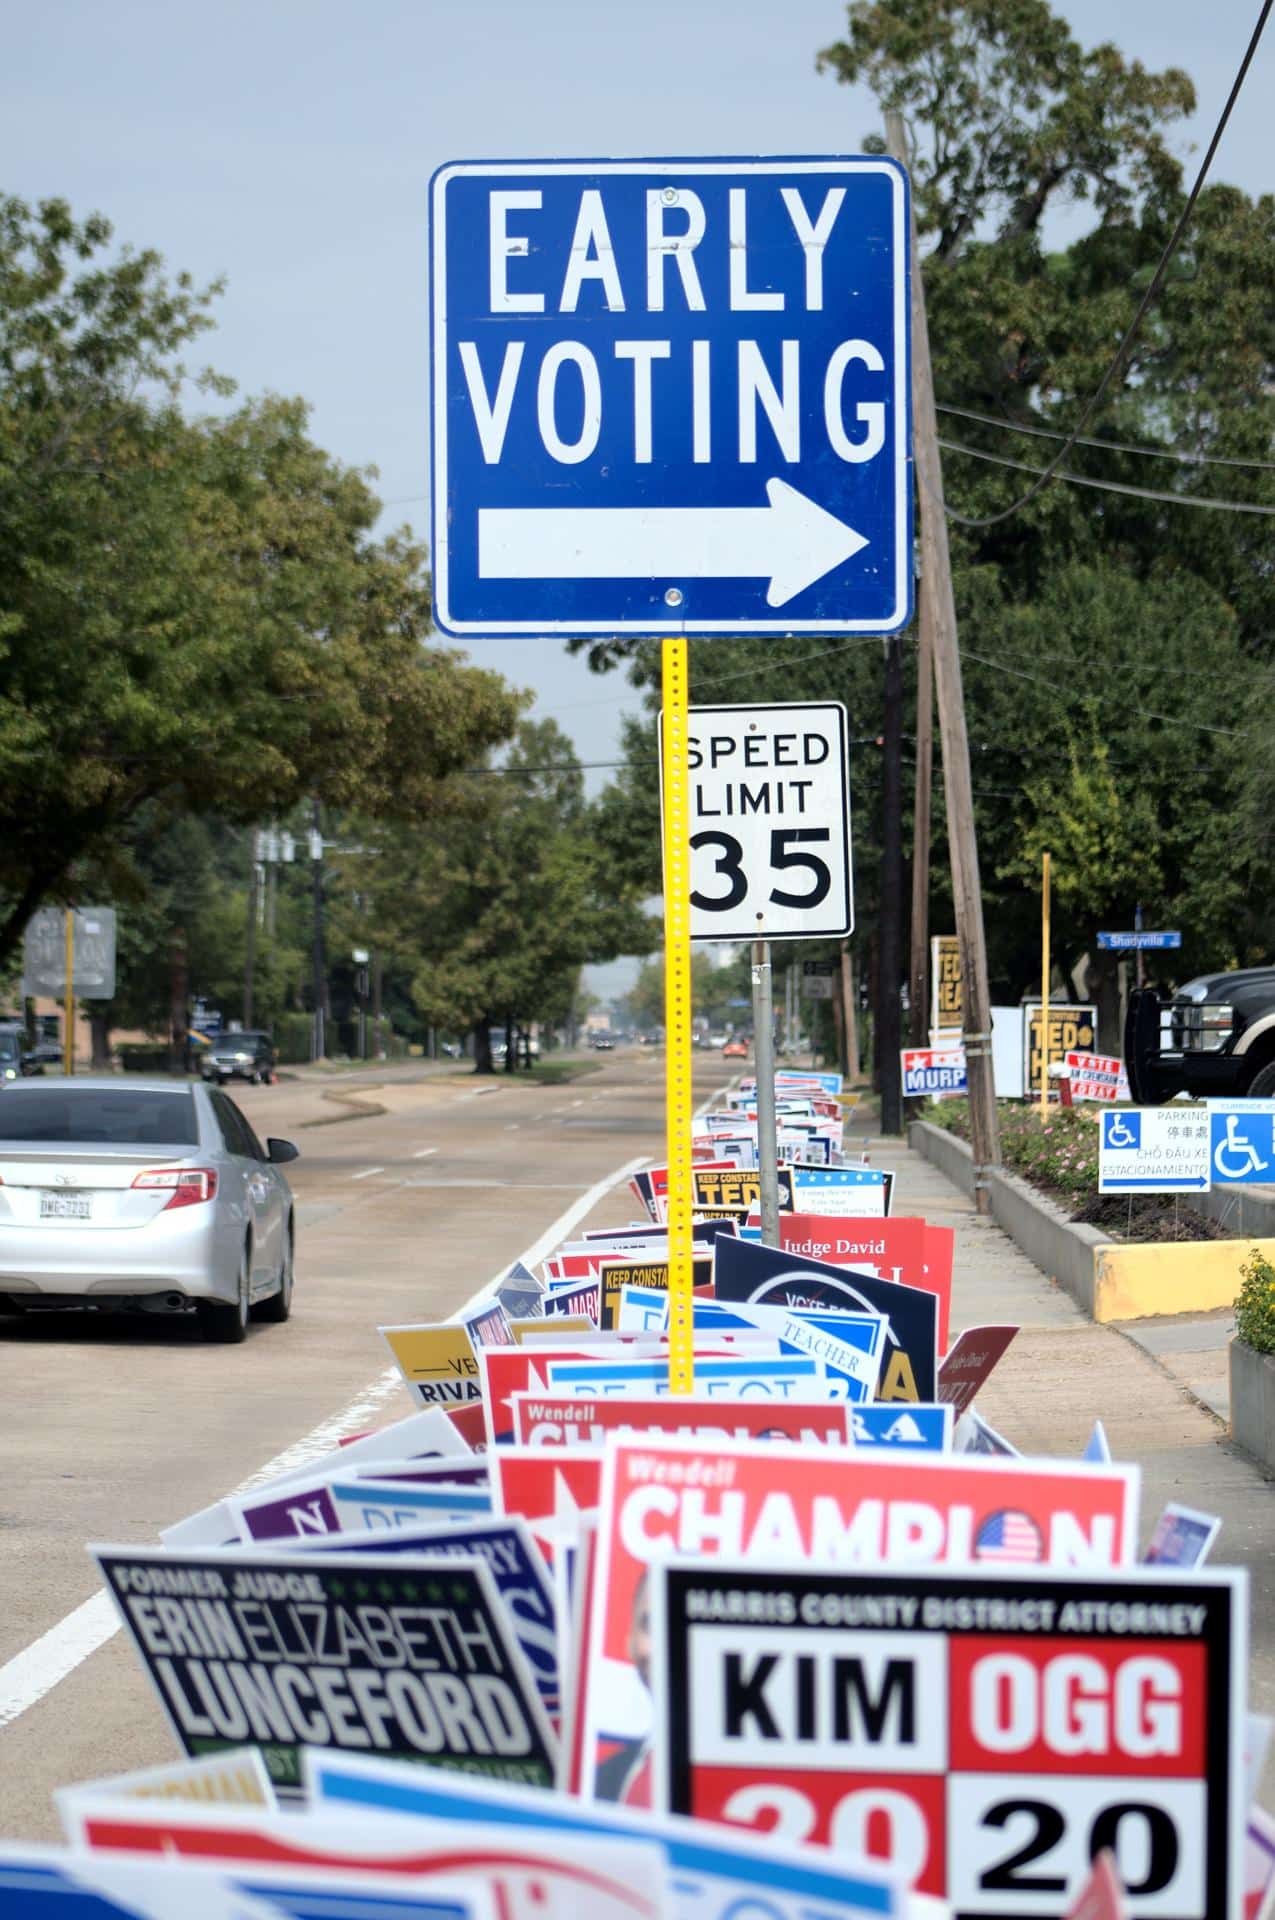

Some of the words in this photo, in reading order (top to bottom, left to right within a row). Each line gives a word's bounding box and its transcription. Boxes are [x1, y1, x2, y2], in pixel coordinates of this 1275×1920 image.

[489, 187, 847, 312] EARLY
[458, 338, 886, 465] VOTING
[688, 733, 829, 769] SPEED
[697, 781, 813, 816] LIMIT
[689, 828, 831, 912] 35
[1031, 1022, 1077, 1049] TED
[1157, 1111, 1209, 1121] PARKING
[784, 1239, 831, 1257] Judge
[836, 1239, 886, 1254] David
[528, 1404, 595, 1422] Wendell
[627, 1454, 737, 1487] Wendell
[113, 1566, 228, 1598] FORMER
[233, 1571, 327, 1601] JUDGE
[687, 1592, 796, 1623] HARRIS
[801, 1595, 918, 1626] COUNTY
[922, 1598, 1055, 1631] DISTRICT
[1059, 1602, 1207, 1636] ATTORNEY
[126, 1597, 248, 1661] ERIN
[232, 1600, 502, 1674] ELIZABETH
[155, 1656, 533, 1757] LUNCEFORD
[722, 1650, 917, 1745] KIM
[971, 1653, 1183, 1758] OGG
[978, 1799, 1181, 1896] 20
